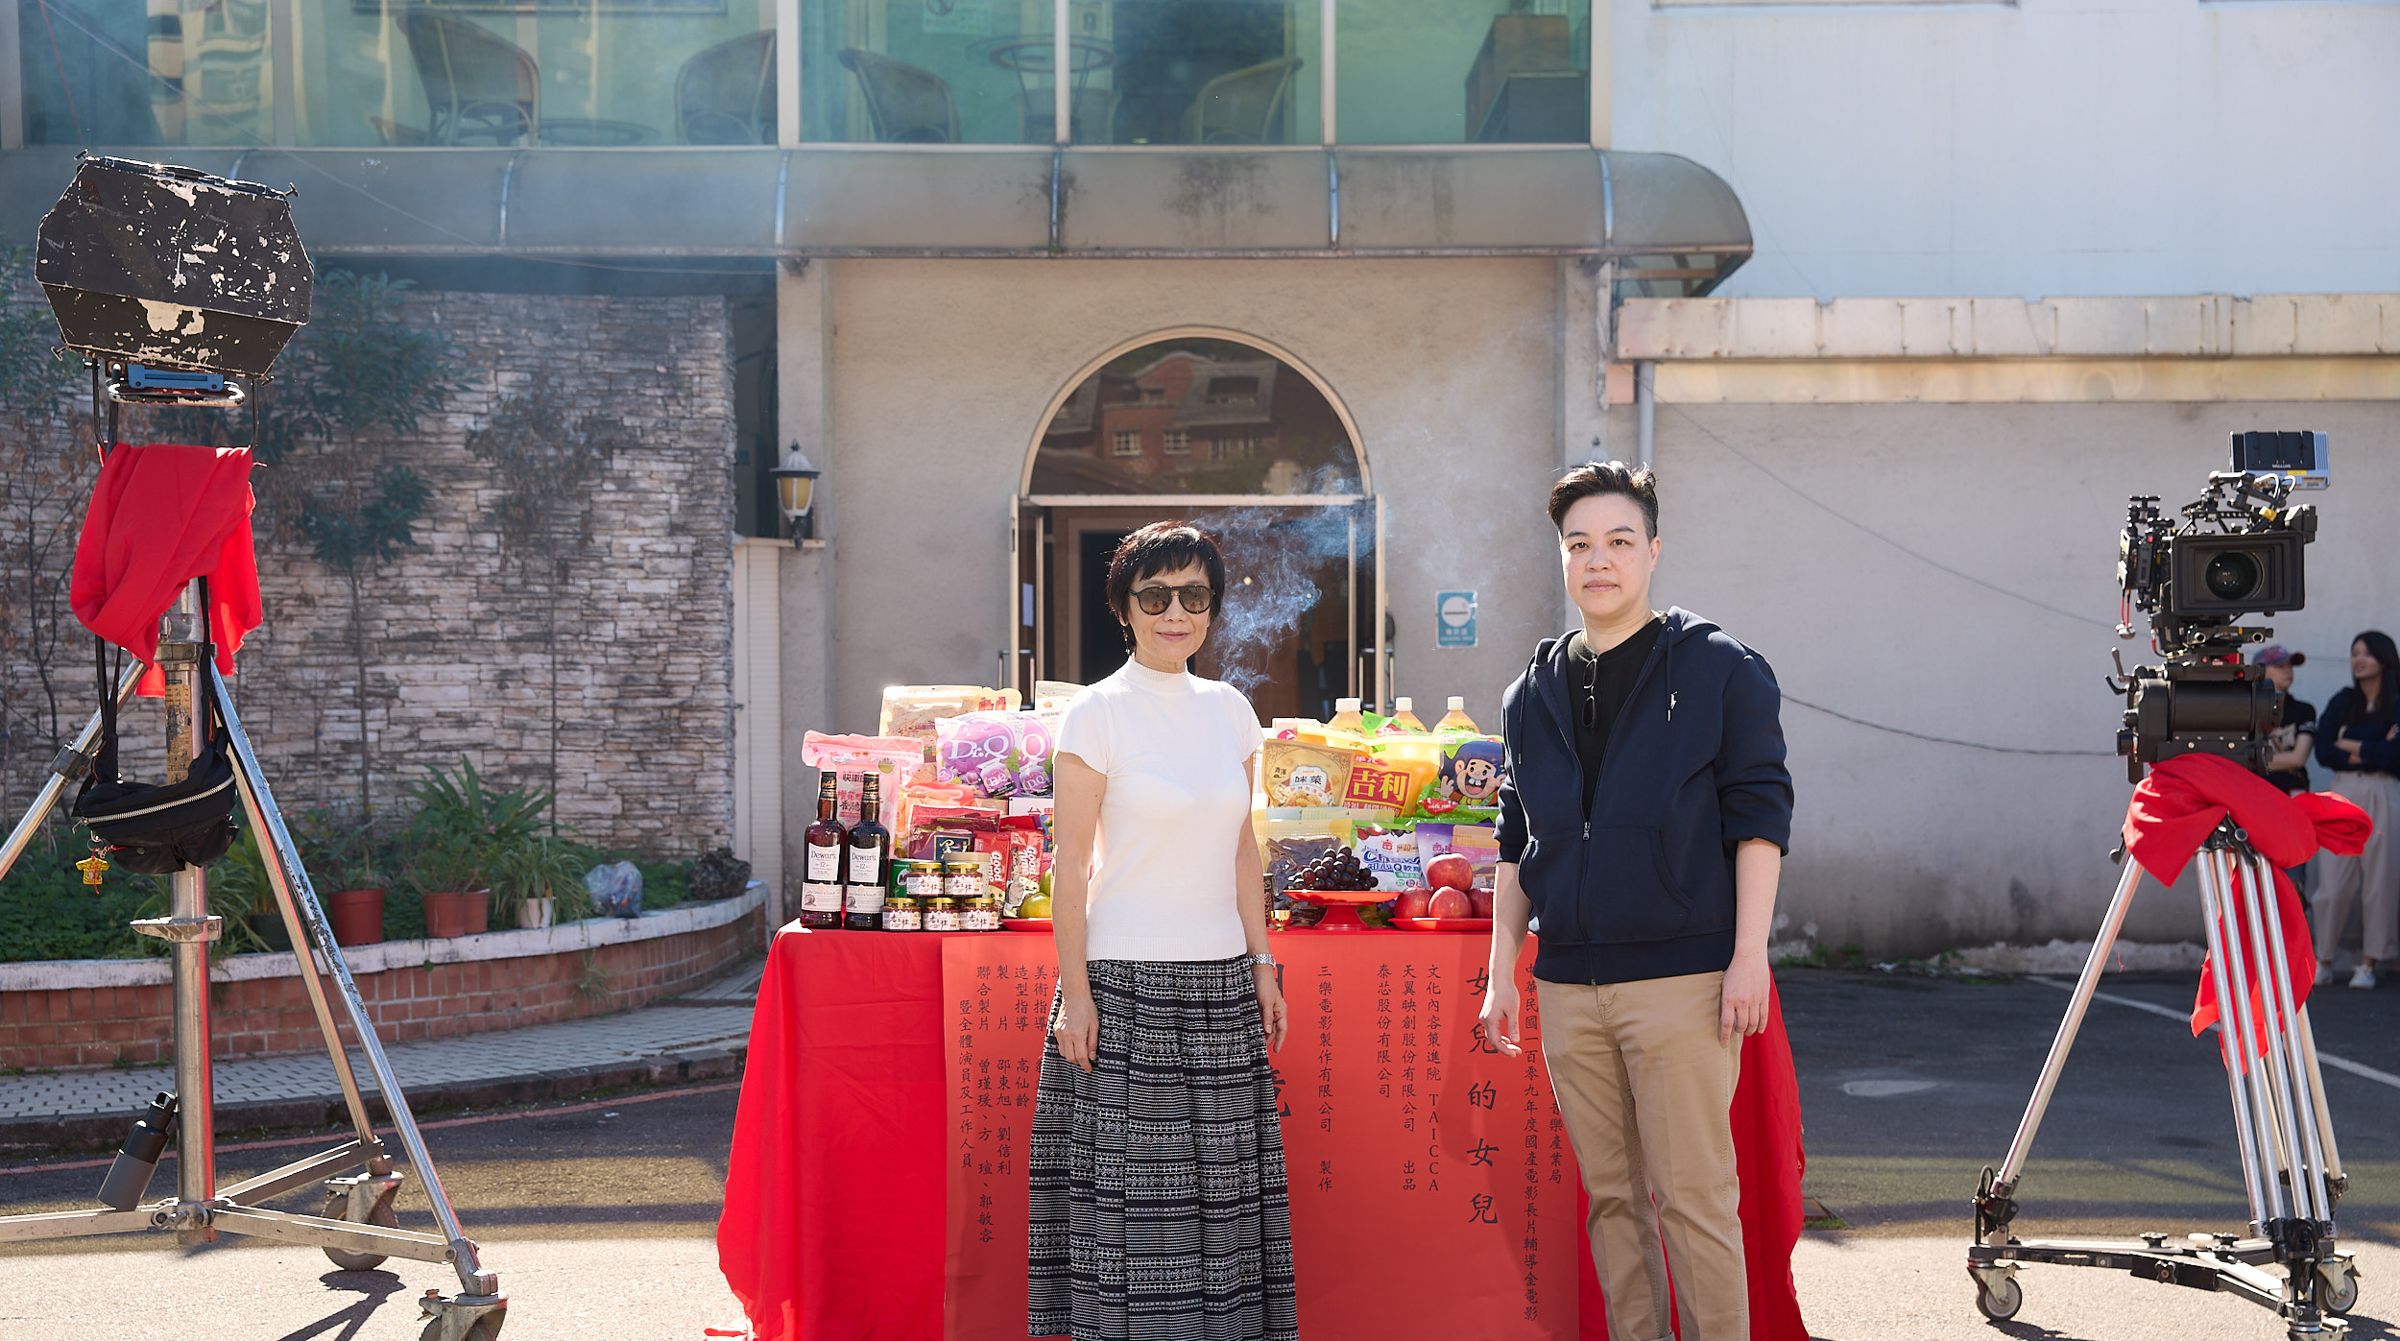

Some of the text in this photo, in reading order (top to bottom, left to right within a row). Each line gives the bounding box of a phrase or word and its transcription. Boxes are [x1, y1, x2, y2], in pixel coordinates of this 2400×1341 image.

[948, 735, 1011, 760] Dr.Q
[1352, 770, 1408, 801] 吉利
[977, 966, 991, 1031] 聯合製片
[1015, 965, 1029, 1031] 造型指導
[1034, 965, 1048, 1031] 美術指導
[1376, 964, 1392, 1098] 泰芯股份有限公司
[959, 999, 974, 1167] 暨全體演員及工作人員
[1318, 965, 1333, 1192] 三樂電影製作有限公司 製作
[1402, 964, 1416, 1191] 天翼映創股份有限公司 出品
[1427, 964, 1441, 1191] 文化內容策進院 TAICCA
[1466, 967, 1500, 1224] 女兒的女兒
